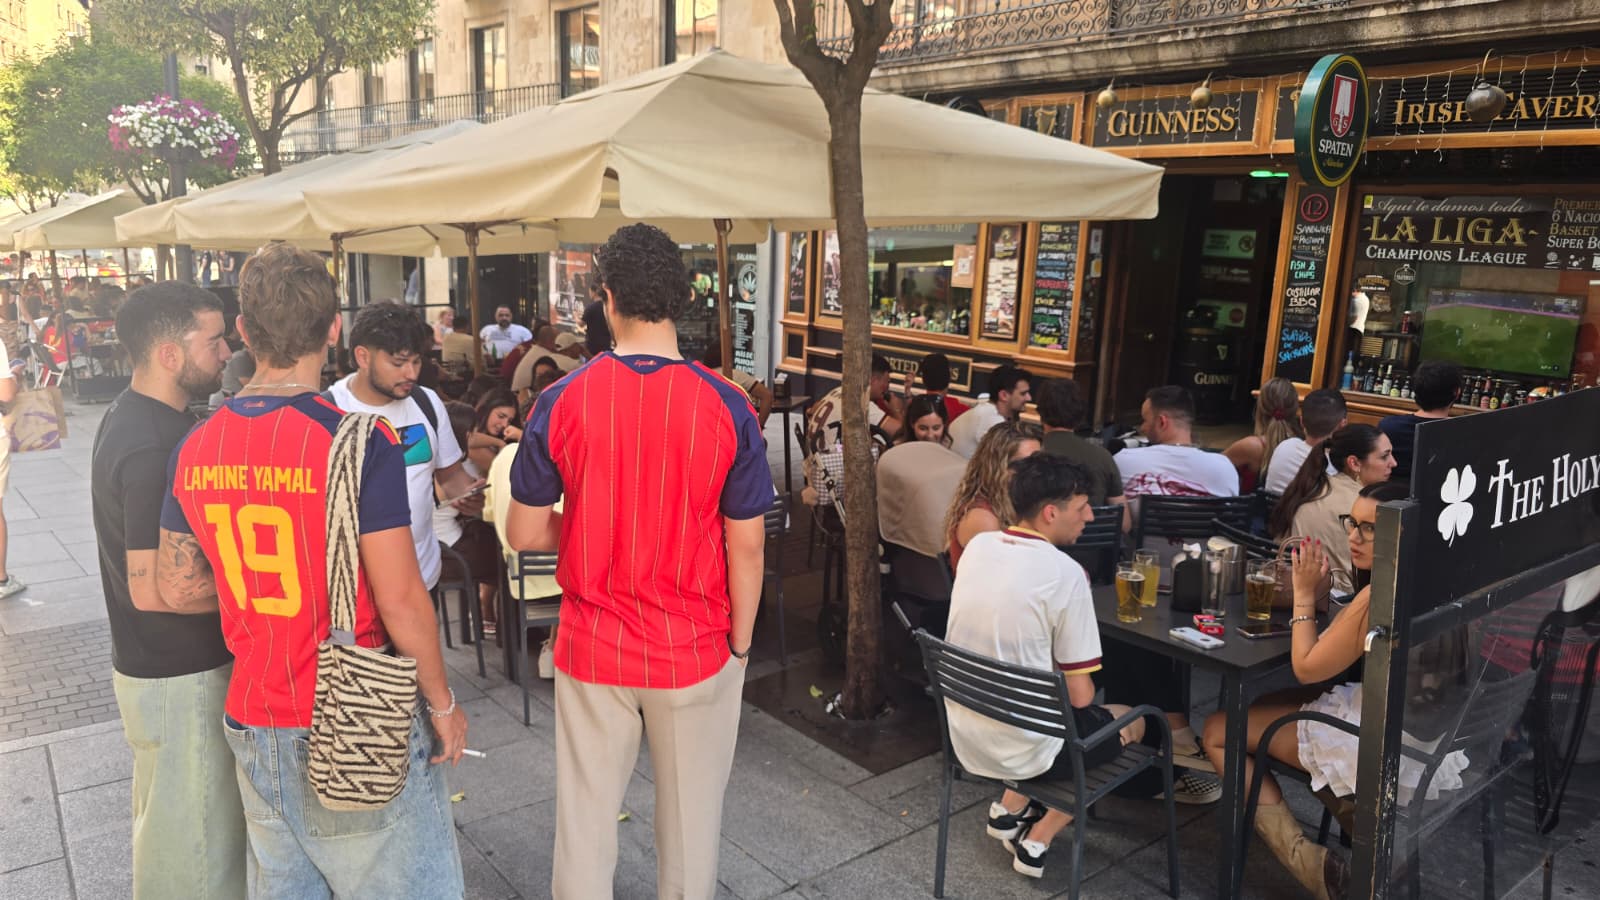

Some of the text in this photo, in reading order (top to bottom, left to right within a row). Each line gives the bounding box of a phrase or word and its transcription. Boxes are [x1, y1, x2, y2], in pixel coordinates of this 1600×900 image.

[1494, 93, 1600, 121] AVER
[1108, 106, 1238, 137] GUINNESS
[1318, 138, 1354, 158] SPATEN
[1305, 199, 1324, 216] 12
[1430, 198, 1484, 213] damos
[1488, 197, 1527, 214] toda
[1552, 209, 1561, 222] 6
[1369, 215, 1528, 247] LA LIGA
[1549, 222, 1598, 236] BASKET
[1546, 235, 1584, 249] SUPER
[1366, 245, 1528, 266] CHAMPIONS LEAGUE
[1288, 297, 1317, 308] BBQ
[184, 465, 317, 494] LAMINE YAMAL
[1487, 452, 1600, 529] THE HOLY
[203, 503, 302, 618] 19
